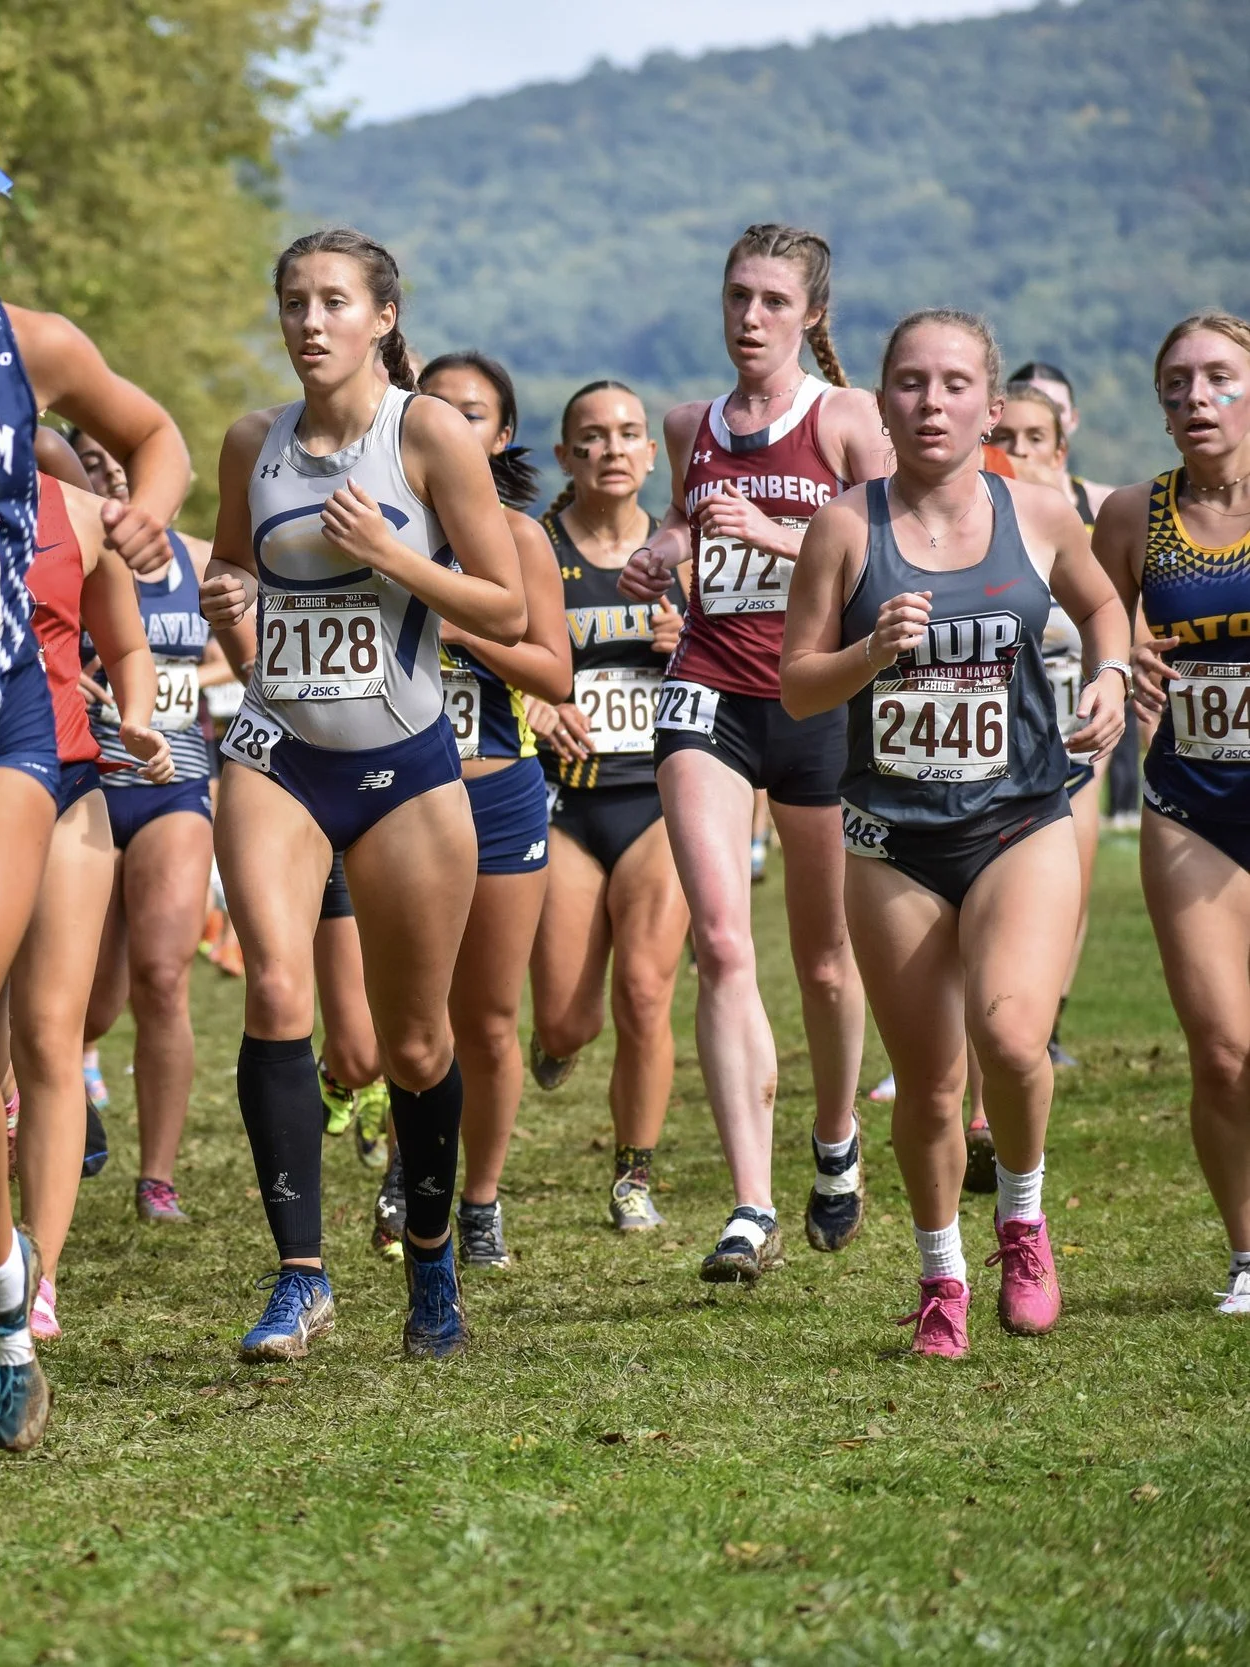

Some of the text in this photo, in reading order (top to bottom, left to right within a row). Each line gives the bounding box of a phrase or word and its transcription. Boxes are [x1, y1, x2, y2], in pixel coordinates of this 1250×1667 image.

[685, 475, 832, 517] MUHENBERG
[295, 597, 327, 608] LEHIGH
[748, 600, 776, 610] asics
[565, 604, 678, 650] VILL
[266, 616, 379, 677] 2128
[912, 614, 1020, 667] IUP
[910, 664, 1007, 679] CRIMSON HAWKS
[1206, 666, 1241, 677] LEHIGH
[311, 685, 340, 698] asics
[917, 680, 956, 692] LEHIGH
[958, 686, 972, 694] Paul
[973, 685, 992, 693] Short
[654, 687, 702, 725] 721
[878, 700, 1004, 758] 2446
[931, 768, 963, 780] asics
